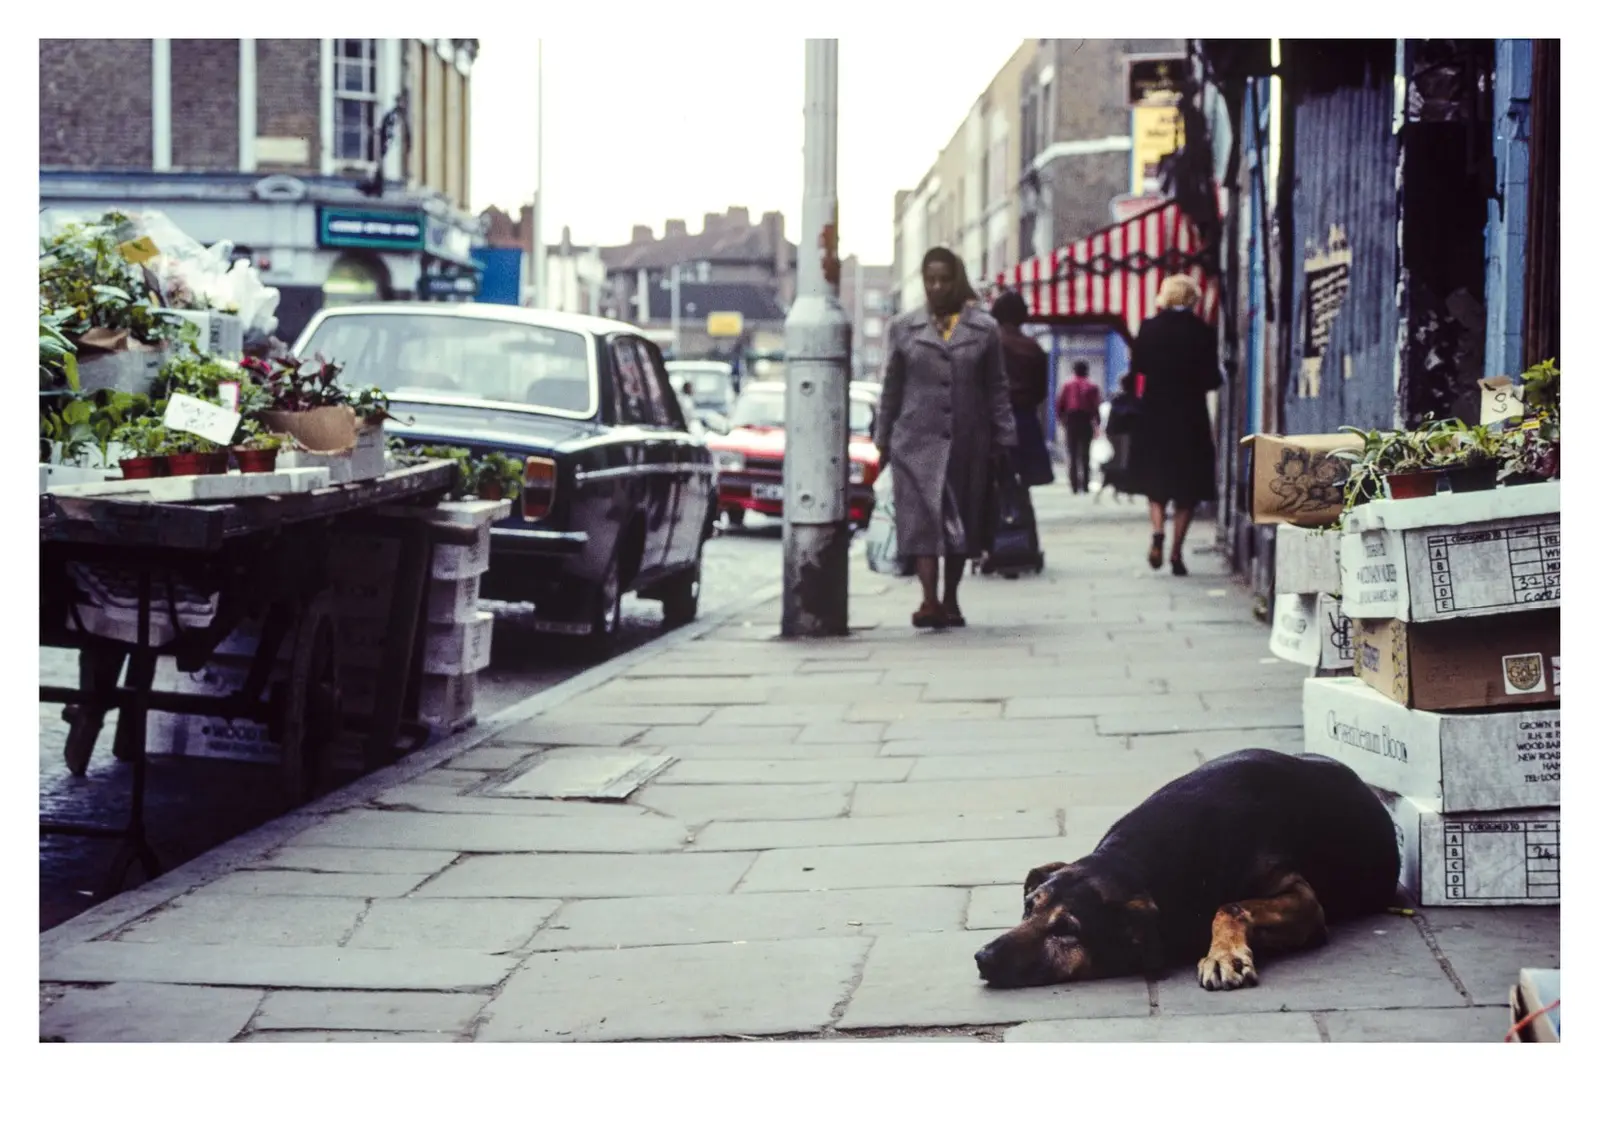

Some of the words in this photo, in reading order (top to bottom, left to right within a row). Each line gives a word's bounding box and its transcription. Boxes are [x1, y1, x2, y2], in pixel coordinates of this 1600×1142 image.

[1435, 547, 1442, 557] A
[1437, 561, 1444, 570] B
[1438, 574, 1445, 583] C
[1518, 576, 1542, 590] 32
[1440, 588, 1447, 596] D
[1442, 600, 1448, 609] E
[1516, 742, 1544, 750] WOOD
[1518, 753, 1537, 761] NEW
[1451, 835, 1458, 843] A
[1451, 848, 1458, 857] B
[1451, 861, 1458, 869] C
[1452, 875, 1459, 883] D
[1452, 888, 1459, 896] E
